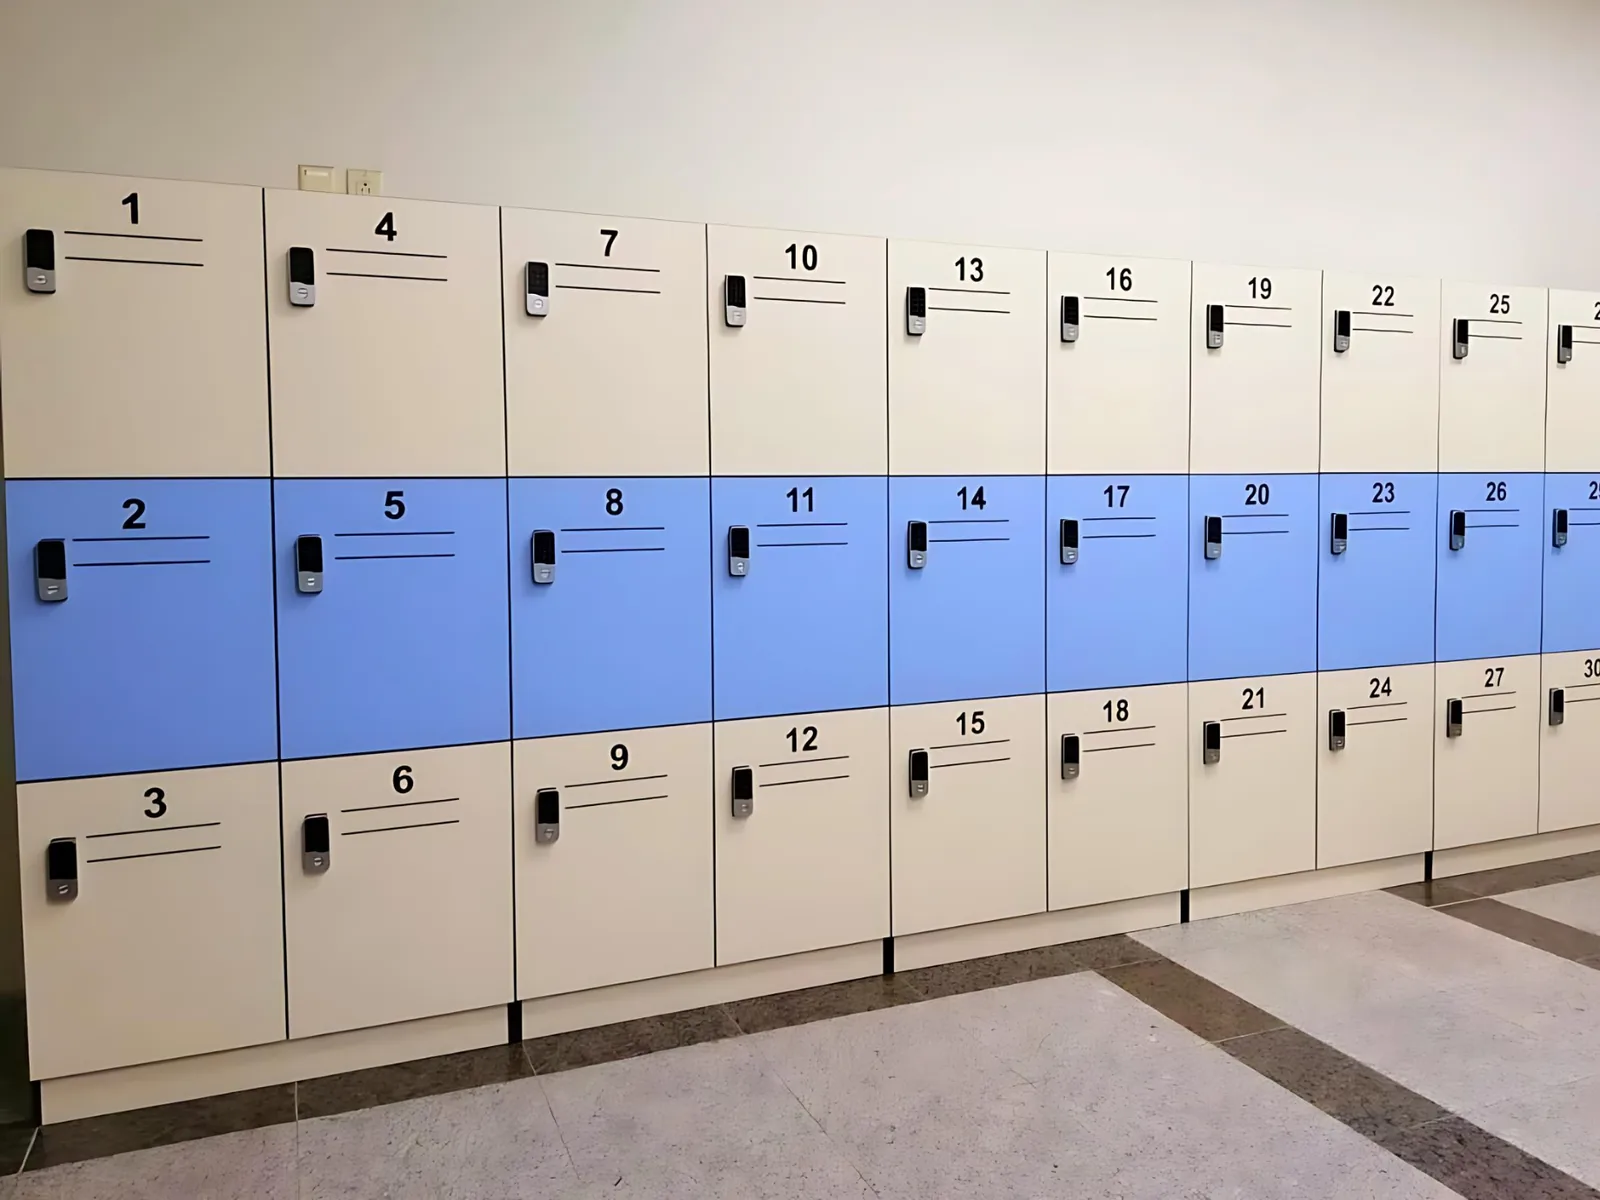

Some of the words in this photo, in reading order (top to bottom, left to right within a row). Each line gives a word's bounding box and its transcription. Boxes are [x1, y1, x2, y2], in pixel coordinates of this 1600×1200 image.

[121, 192, 139, 225] 1
[374, 211, 398, 242] 4
[600, 229, 619, 257] 7
[784, 243, 818, 271] 10
[954, 256, 984, 283] 13
[1106, 266, 1133, 292] 16
[1248, 276, 1272, 300] 19
[1371, 284, 1395, 307] 22
[1489, 293, 1510, 315] 25
[1594, 301, 1600, 320] 2
[605, 488, 624, 516] 8
[786, 486, 814, 513] 11
[956, 485, 987, 511] 14
[1103, 484, 1130, 508] 17
[1244, 483, 1270, 506] 20
[1371, 481, 1395, 503] 23
[1485, 481, 1507, 502] 26
[1588, 480, 1600, 500] 2
[122, 498, 146, 530] 2
[384, 490, 406, 520] 5
[1369, 676, 1393, 699] 24
[1484, 667, 1505, 688] 27
[1102, 698, 1129, 723] 18
[1241, 686, 1264, 710] 21
[956, 710, 985, 736] 15
[786, 725, 818, 753] 12
[610, 743, 629, 771] 9
[392, 765, 414, 794] 6
[143, 787, 167, 819] 3
